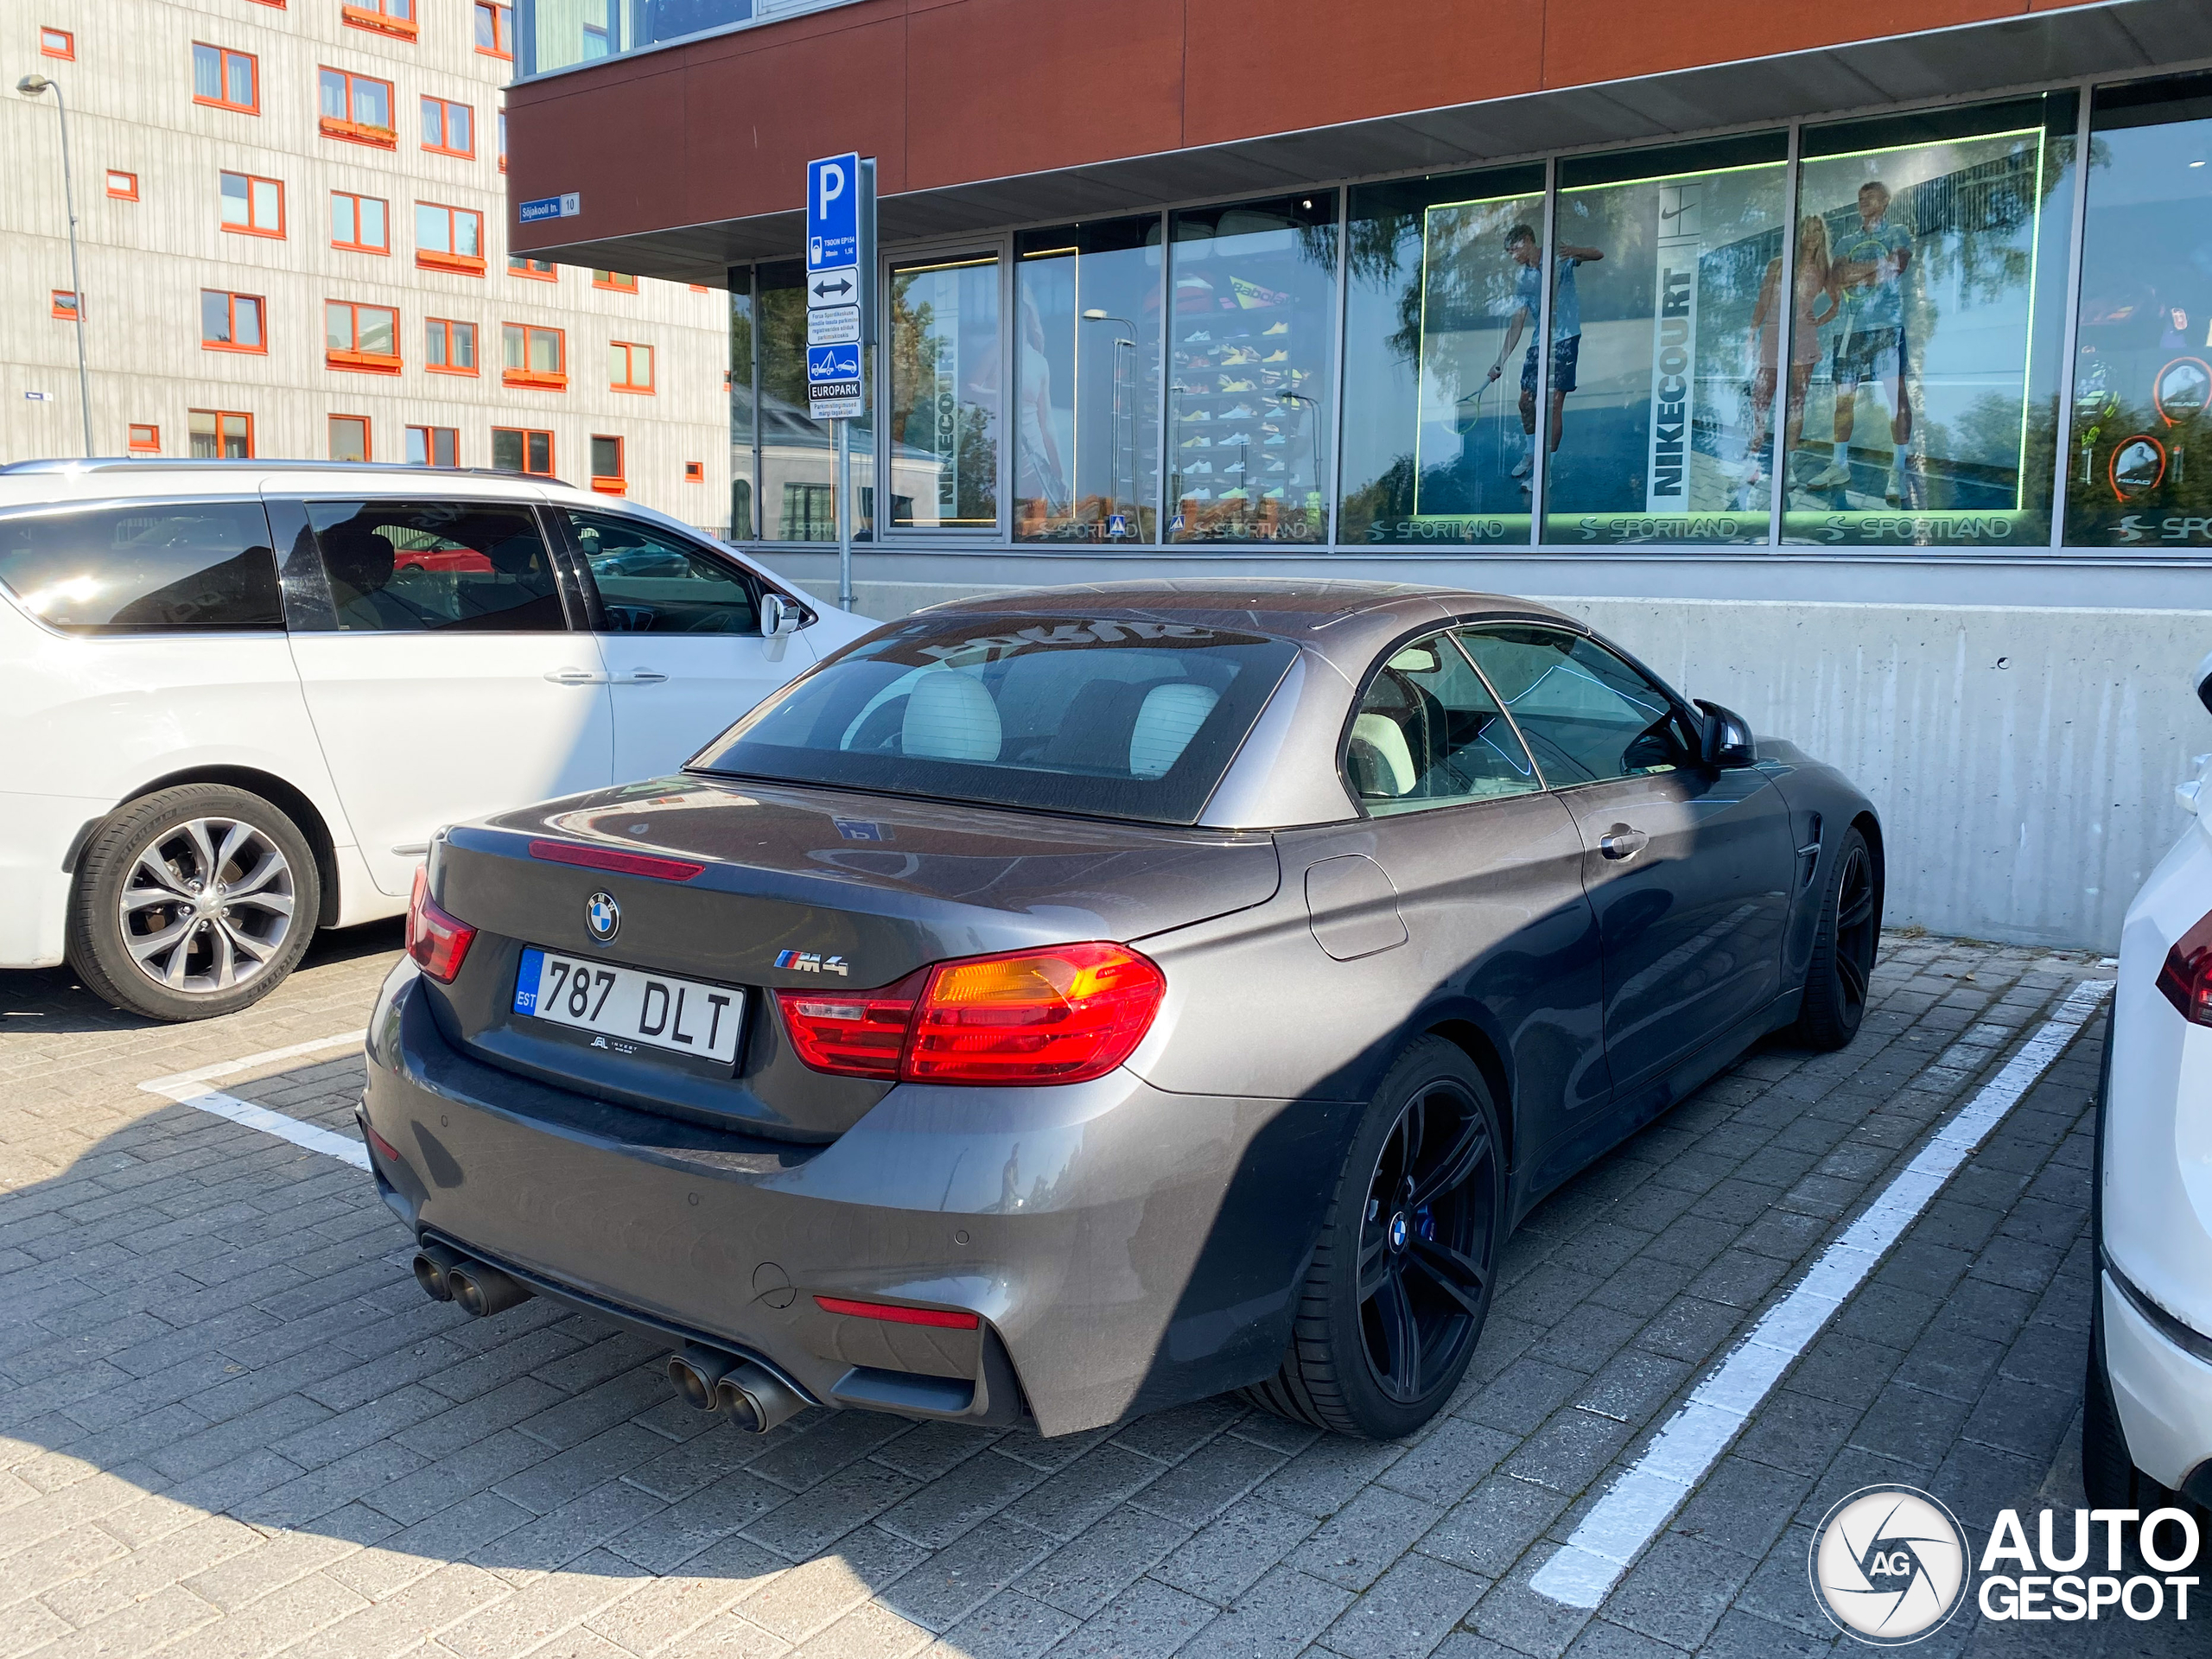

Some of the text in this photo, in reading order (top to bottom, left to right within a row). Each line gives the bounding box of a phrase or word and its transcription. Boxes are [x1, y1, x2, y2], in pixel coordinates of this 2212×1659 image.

[819, 163, 845, 220] P
[522, 203, 549, 219] Sõjakooli
[566, 198, 575, 211] 10
[841, 236, 855, 245] EP154
[812, 385, 857, 397] EUROPARK
[1653, 267, 1691, 497] NIKECOURT
[1058, 523, 1138, 538] SPORTLD
[1214, 522, 1306, 540] SPORTLAND
[1395, 519, 1505, 539] SPORTLAND
[1609, 518, 1738, 538] SPORTLAND
[1859, 517, 2012, 538] SPORTLAND
[121, 808, 177, 861] MICHELIN
[794, 952, 849, 977] M4
[517, 991, 537, 1007] EST
[544, 961, 731, 1050] 787 DLT
